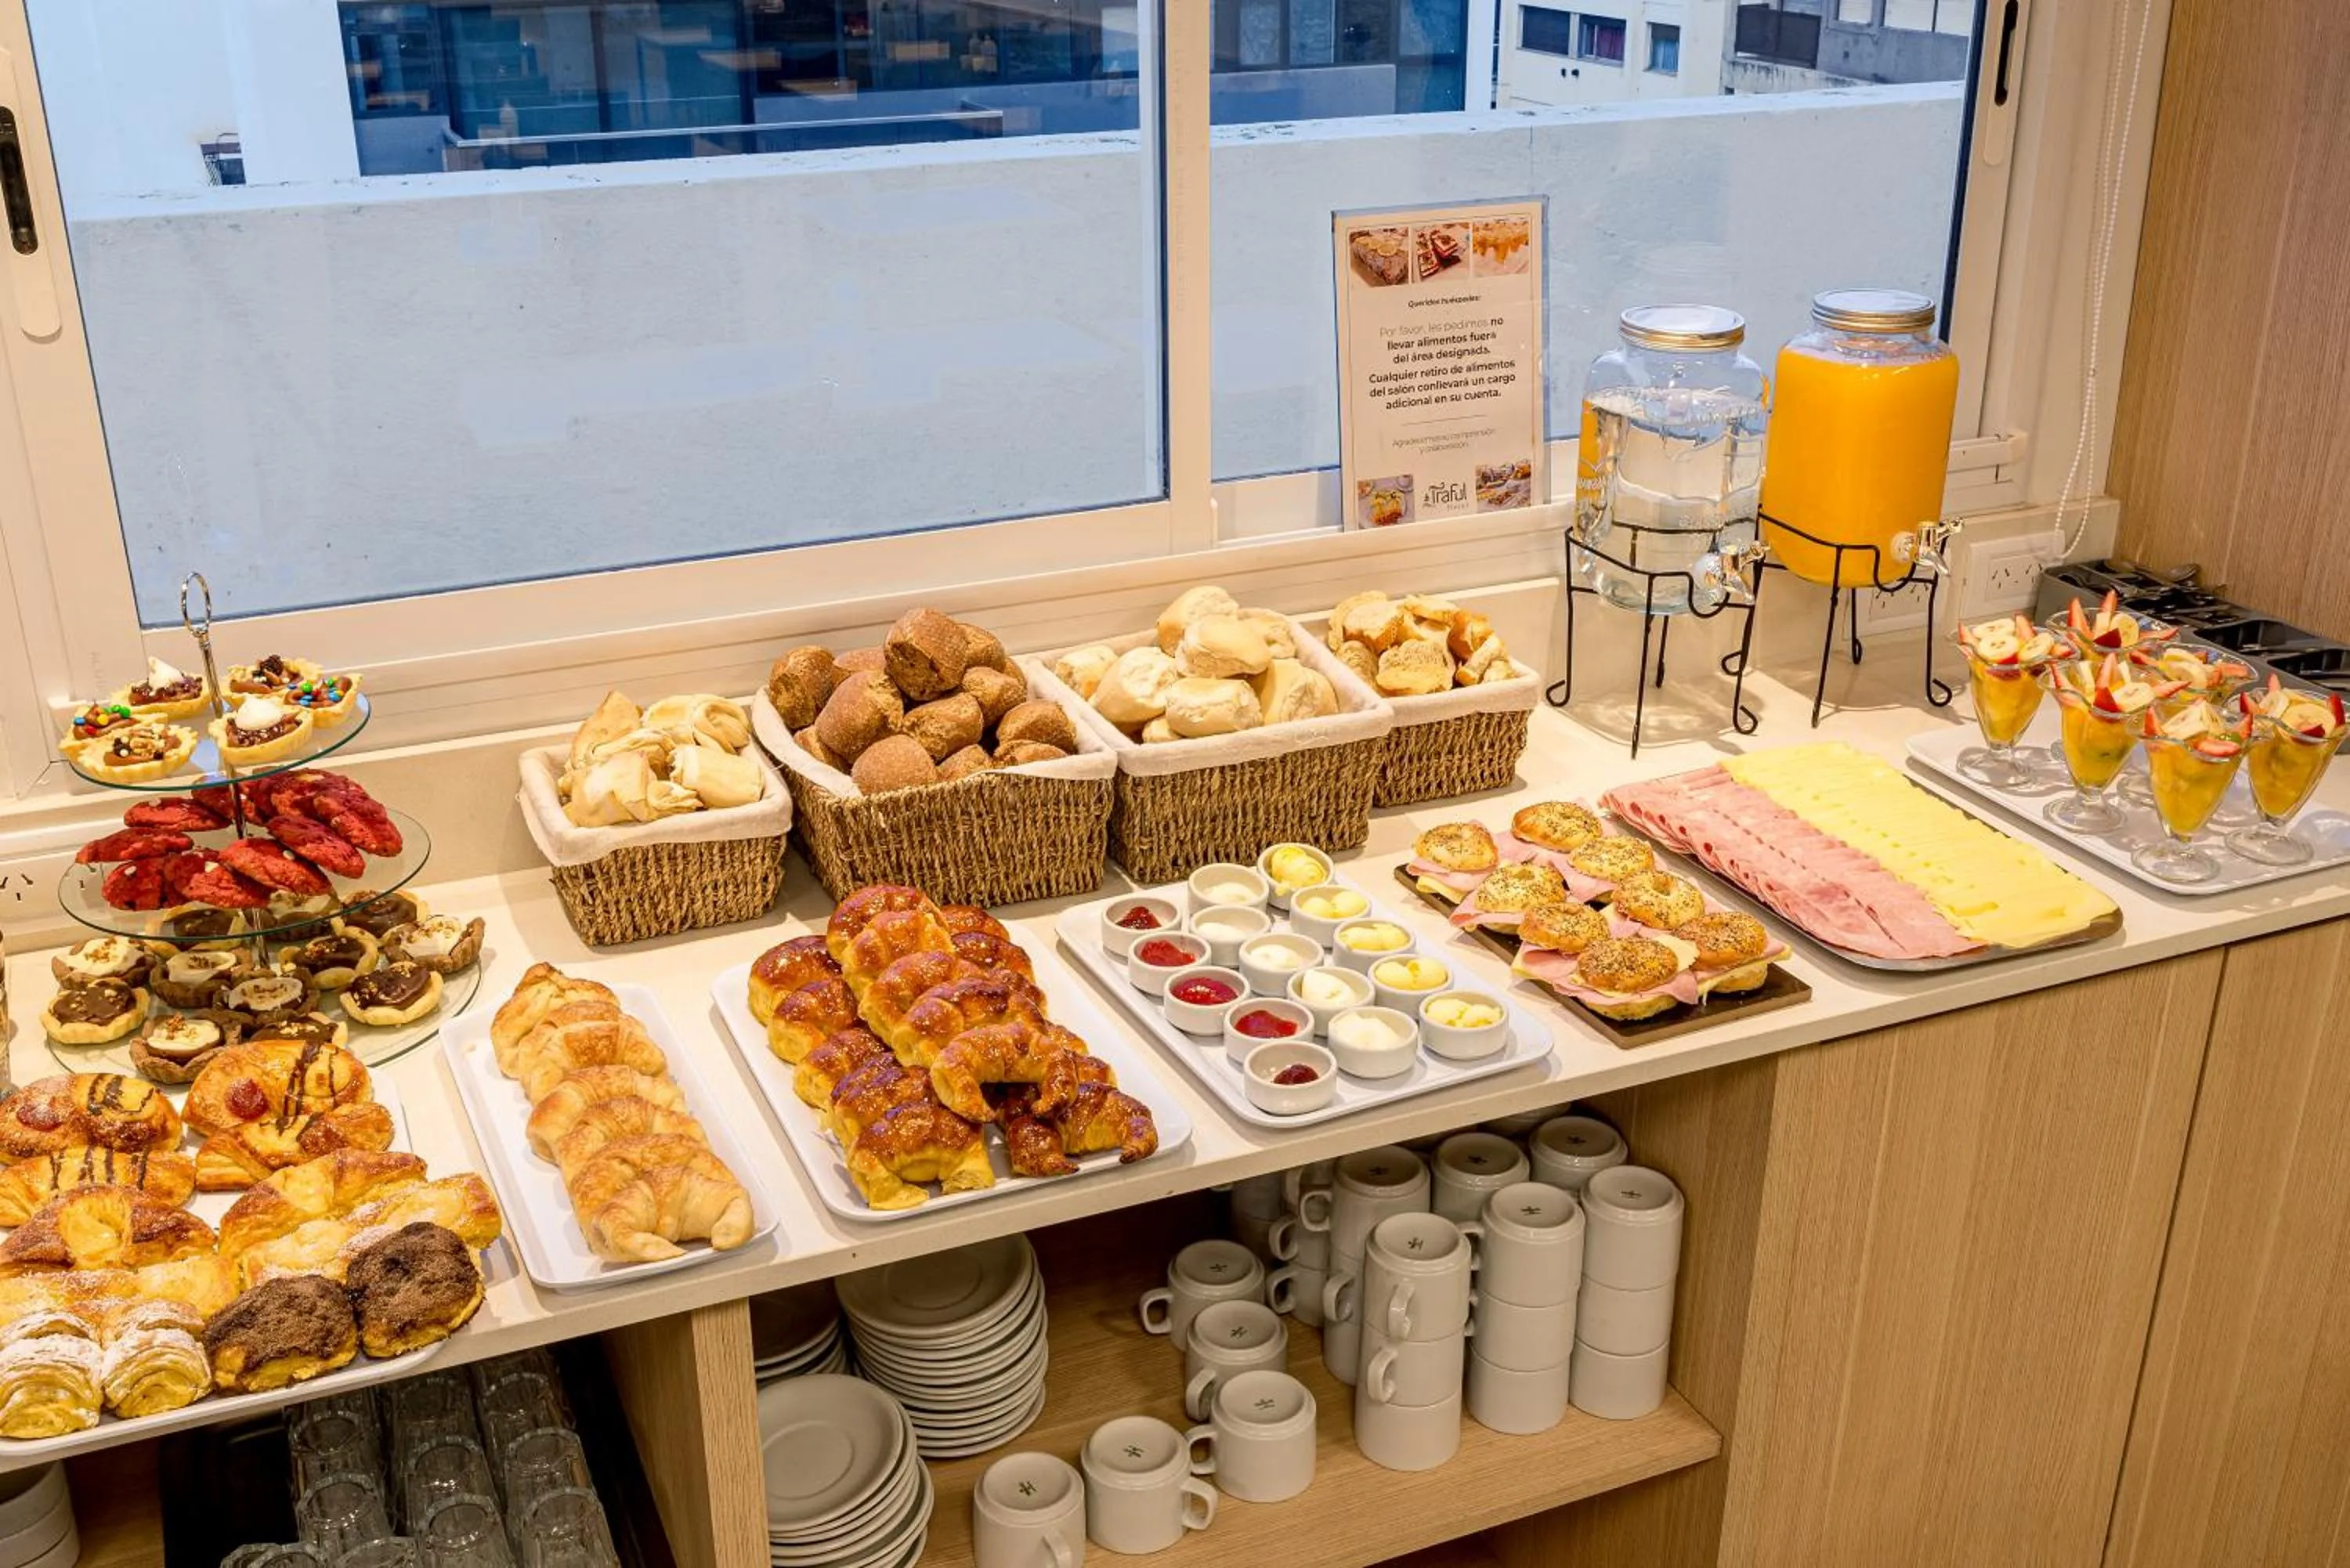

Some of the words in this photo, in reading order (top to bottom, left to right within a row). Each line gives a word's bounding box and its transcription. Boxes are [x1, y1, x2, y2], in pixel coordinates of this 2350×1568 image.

[1491, 316, 1504, 326] no
[1387, 340, 1415, 351] llevar
[1417, 334, 1467, 348] alimentos
[1470, 331, 1497, 341] fuera
[1393, 353, 1409, 364] del
[1411, 352, 1434, 362] área
[1368, 369, 1419, 383] Cualquier
[1420, 366, 1448, 378] retiro
[1450, 364, 1464, 374] de
[1466, 359, 1516, 373] alimentos
[1368, 386, 1386, 398] del
[1387, 383, 1415, 396] salón
[1417, 378, 1470, 392] conllevará
[1471, 376, 1485, 386] un
[1488, 372, 1516, 385] cargo
[1386, 396, 1433, 410] adicional
[1434, 393, 1448, 403] en
[1449, 392, 1462, 402] su
[1464, 388, 1502, 400] cuenta.
